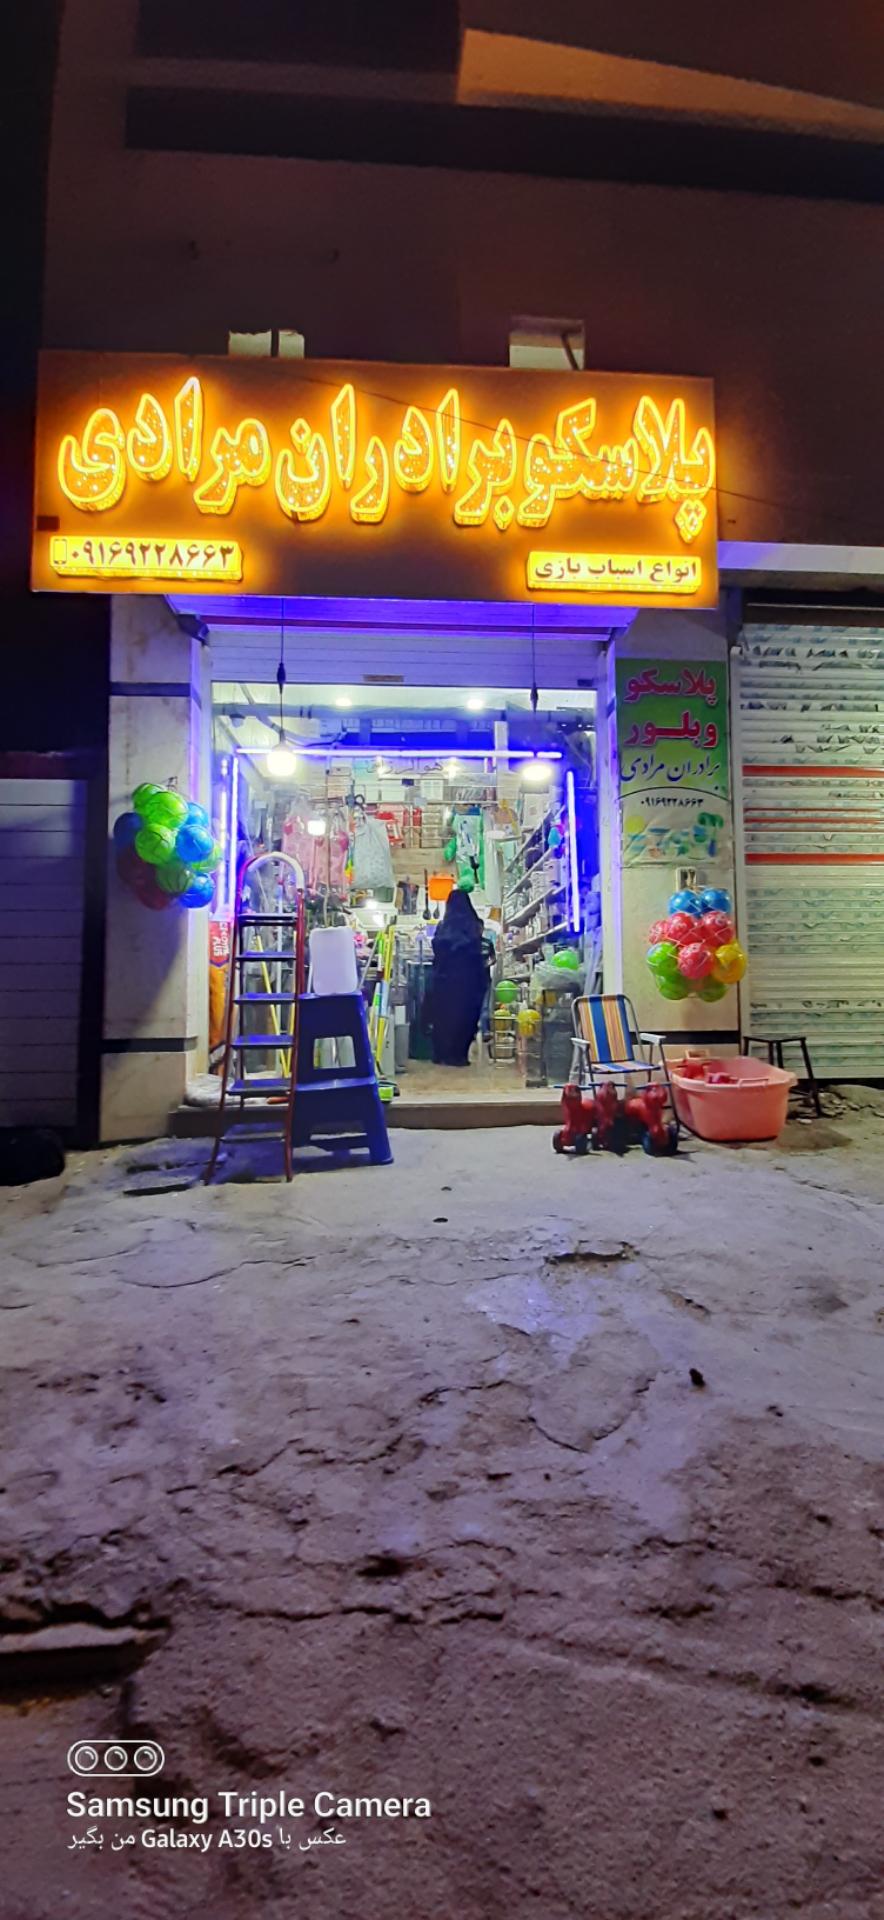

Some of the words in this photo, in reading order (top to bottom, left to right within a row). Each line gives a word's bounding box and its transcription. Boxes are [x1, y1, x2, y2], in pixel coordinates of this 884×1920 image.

[57, 376, 270, 513] مرادی
[275, 383, 516, 530] برادران
[517, 395, 716, 543] پلاسکو
[535, 557, 581, 580] بازی
[587, 558, 642, 580] اسباب
[649, 560, 697, 583] انواع
[623, 667, 717, 706] پلاسکو
[620, 753, 666, 782] مرادی
[666, 754, 720, 790] برادران
